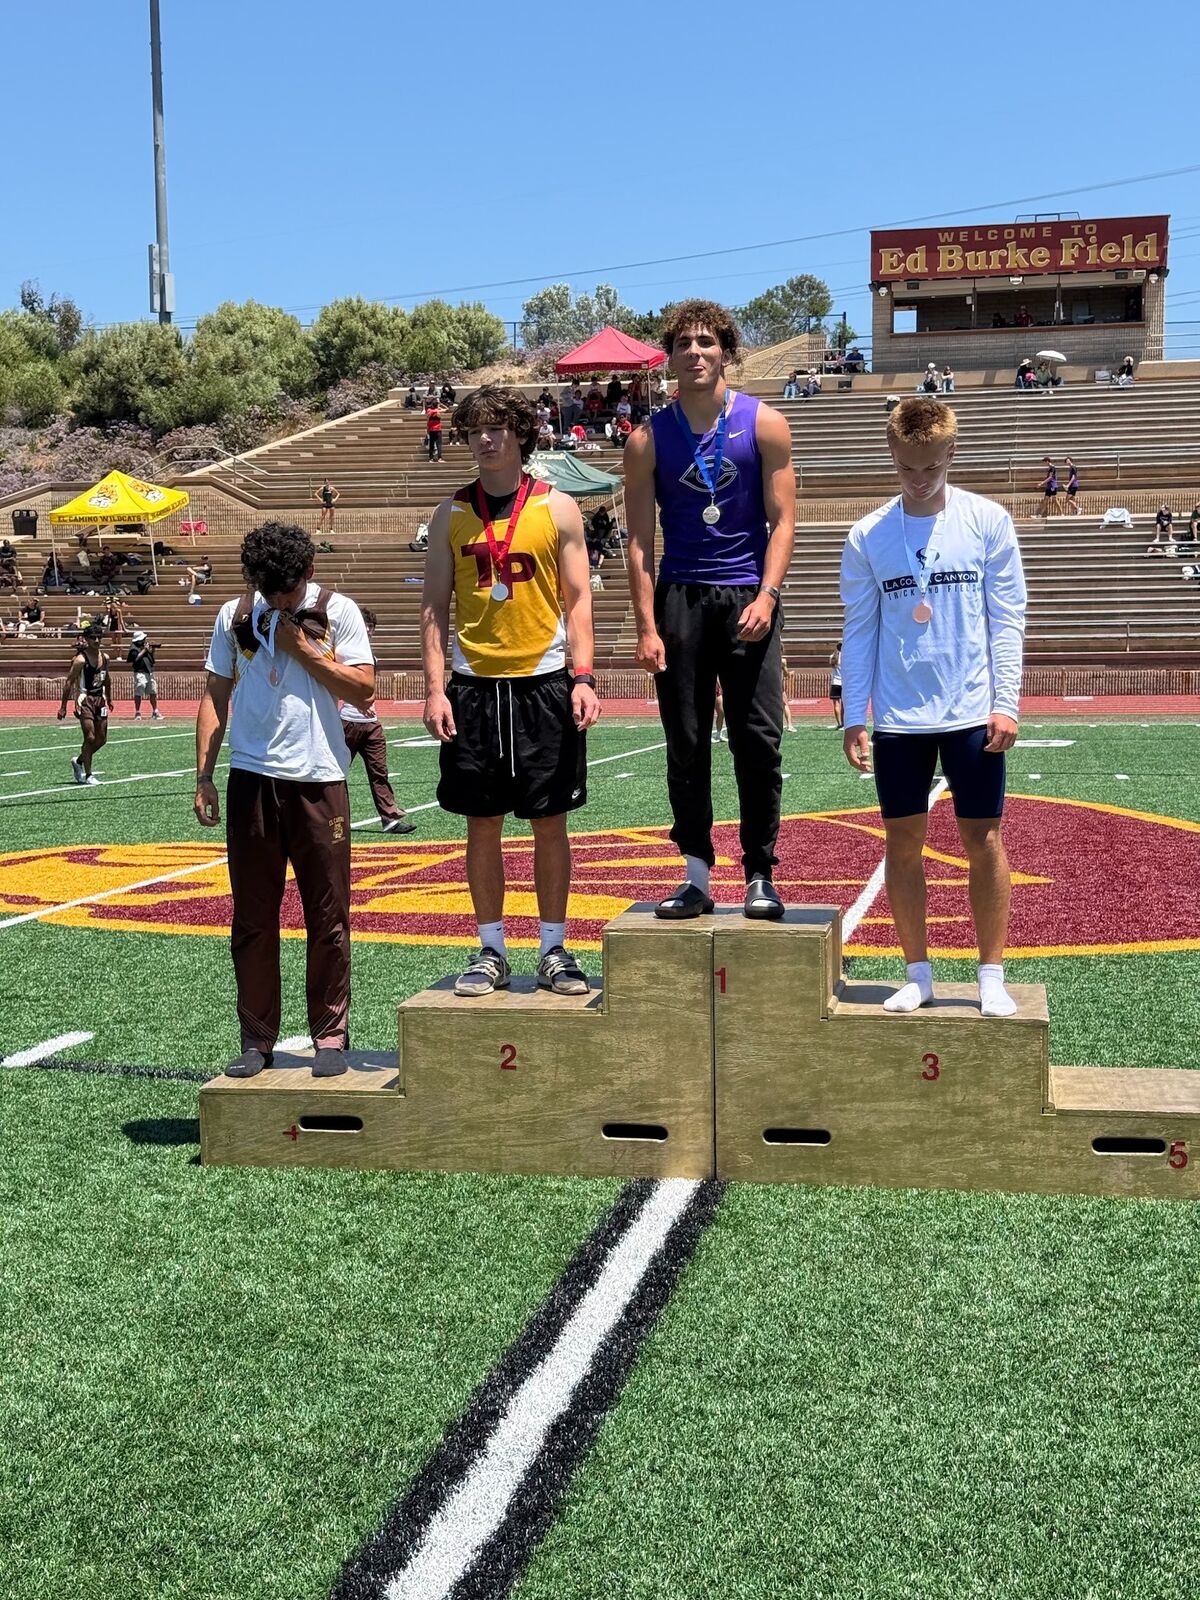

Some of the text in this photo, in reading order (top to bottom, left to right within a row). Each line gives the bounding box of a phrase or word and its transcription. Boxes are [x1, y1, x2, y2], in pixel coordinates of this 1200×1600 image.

[938, 224, 1097, 243] WELCOME TO
[879, 233, 1159, 275] Ed Burke Field
[934, 573, 976, 583] CANYON
[714, 967, 726, 993] 1
[501, 1045, 516, 1070] 2
[922, 1053, 940, 1080] 3
[1170, 1141, 1188, 1168] 5
